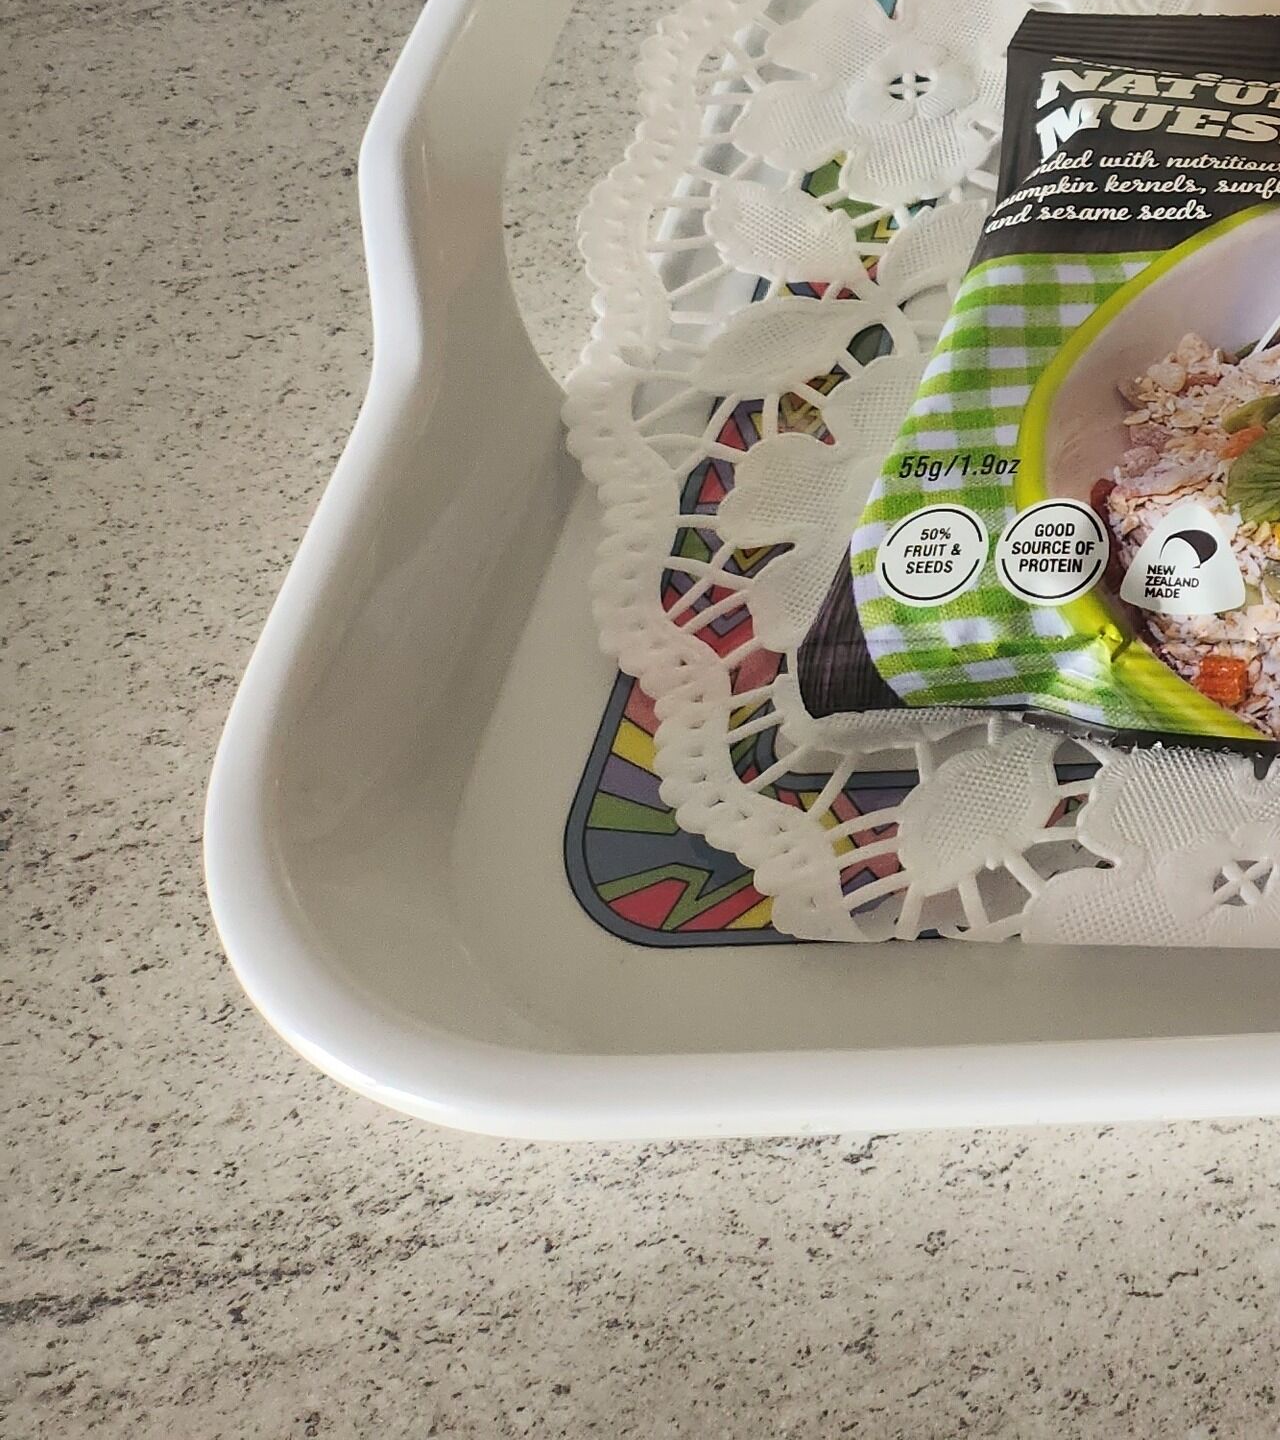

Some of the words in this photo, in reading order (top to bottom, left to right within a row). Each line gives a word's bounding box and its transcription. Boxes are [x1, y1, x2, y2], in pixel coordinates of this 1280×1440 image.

[1100, 150, 1160, 169] with
[1104, 174, 1207, 194] kernels,
[985, 204, 1032, 234] and
[1037, 204, 1132, 220] sesame
[1137, 200, 1212, 220] seeds
[899, 454, 1022, 481] 55g/1.9oz
[920, 527, 951, 541] 50%
[1034, 523, 1075, 537] GOOD
[904, 544, 947, 558] FRUIT
[951, 543, 961, 556] &
[1011, 541, 1070, 555] SOURCE
[1075, 541, 1095, 556] OF
[905, 560, 953, 574] SEEDS
[1019, 559, 1083, 573] PROTEIN
[1147, 564, 1176, 575] NEW
[1145, 575, 1199, 588] ZEALAND
[1144, 587, 1180, 598] MADE
